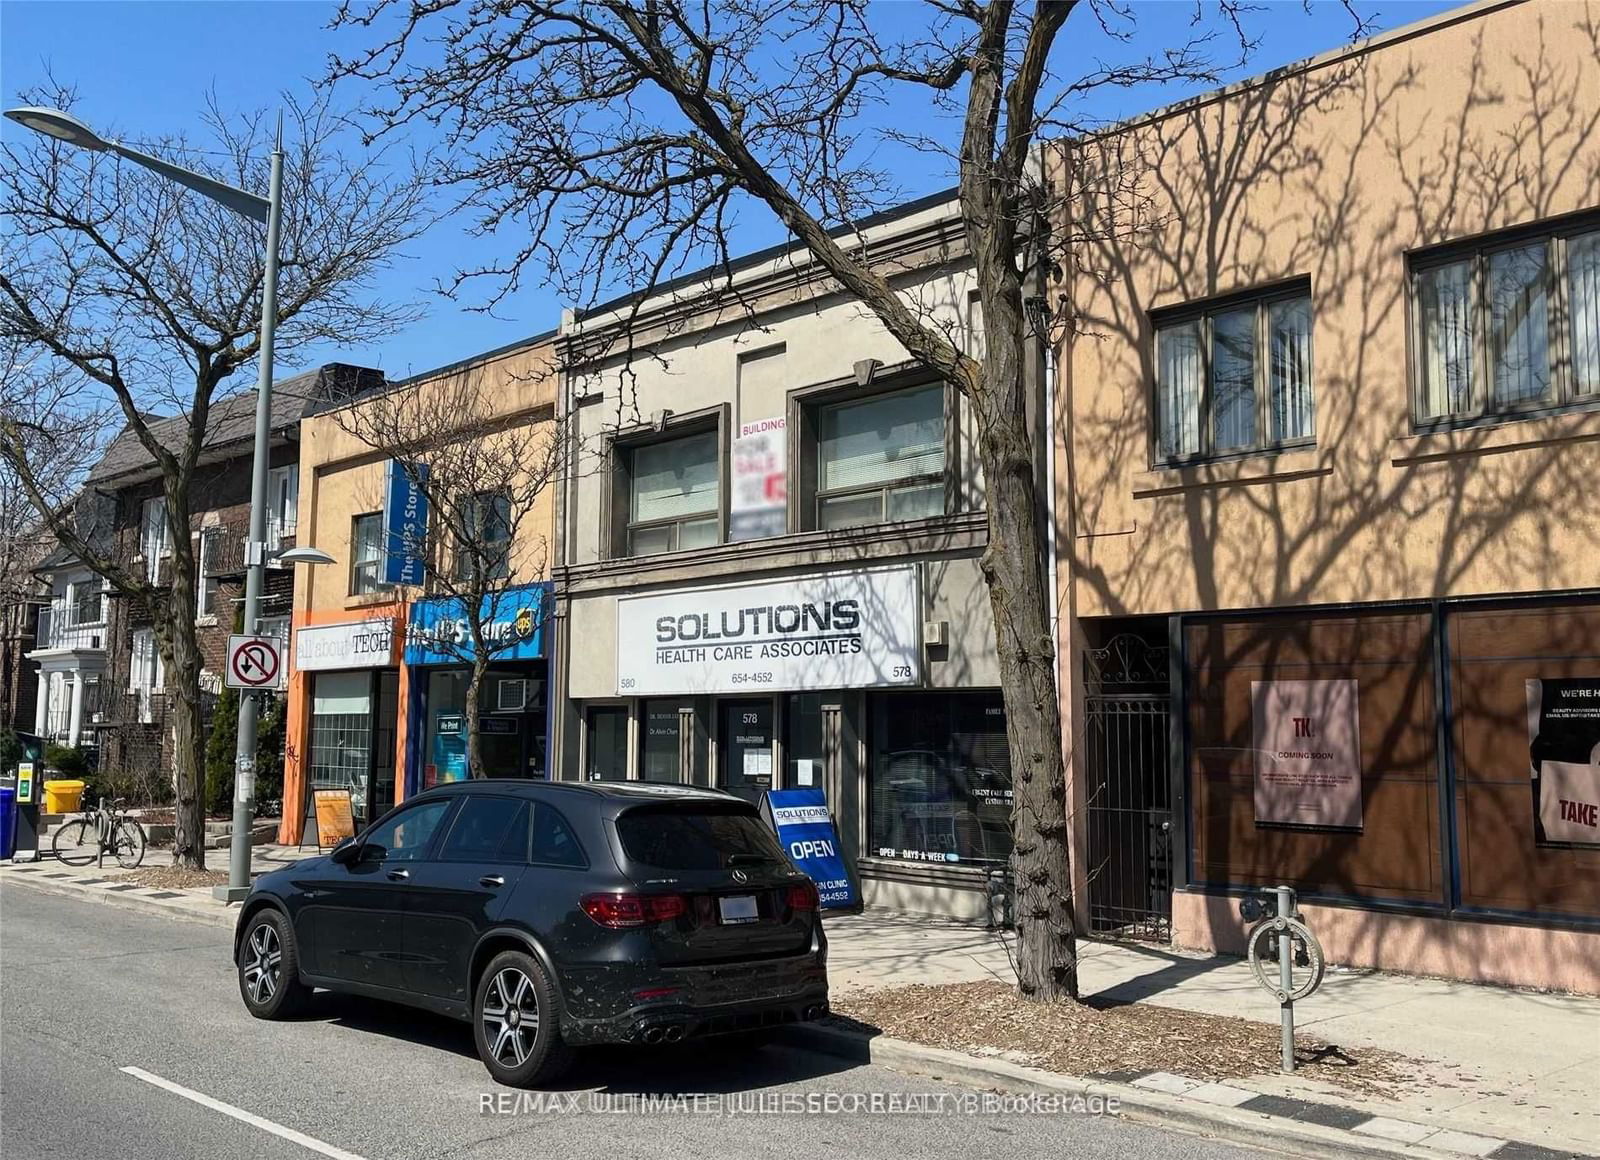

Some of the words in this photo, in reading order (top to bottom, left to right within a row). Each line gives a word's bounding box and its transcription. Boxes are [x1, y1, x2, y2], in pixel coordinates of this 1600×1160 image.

[743, 419, 785, 435] BUILDING
[404, 482, 418, 519] Store
[656, 600, 860, 642] SOLUTIONS
[298, 642, 312, 659] all
[315, 639, 348, 658] about
[353, 632, 389, 654] TECH
[656, 649, 706, 664] HEALTH
[713, 647, 752, 661] CARE
[760, 638, 861, 659] ASSOCIATES
[732, 672, 772, 684] 654-4552
[893, 666, 911, 678] 578
[621, 678, 635, 688] 580
[1561, 689, 1591, 698] WE'RE
[743, 713, 757, 723] 578
[1278, 751, 1309, 759] COMING
[1311, 752, 1334, 760] SOON
[776, 808, 828, 818] SOLUTIONS
[1559, 799, 1598, 828] TAKE
[790, 840, 835, 860] OPEN
[879, 847, 895, 857] OPEN
[903, 849, 919, 860] DAYS
[921, 850, 926, 860] A
[928, 850, 946, 862] WEEK
[827, 879, 848, 888] CLINIC
[820, 891, 848, 902] 54-4552
